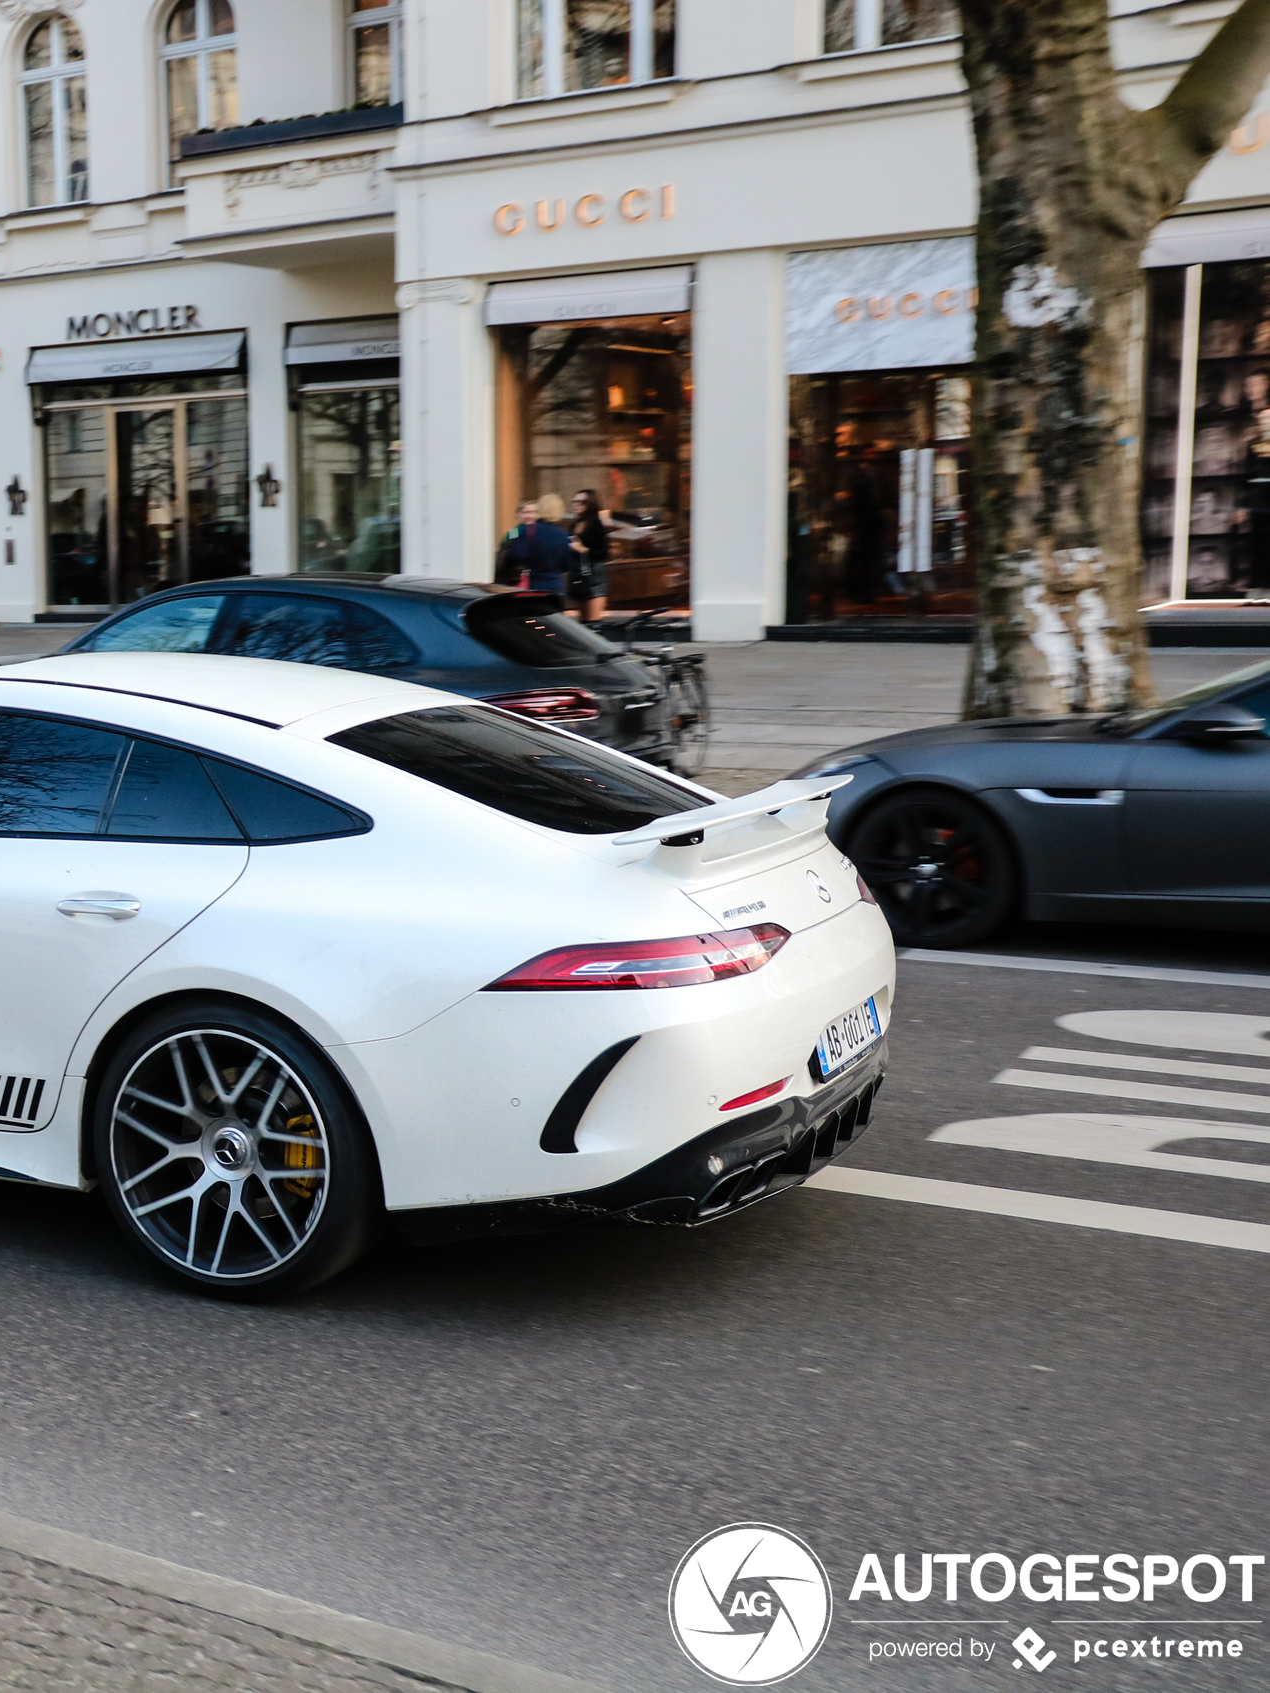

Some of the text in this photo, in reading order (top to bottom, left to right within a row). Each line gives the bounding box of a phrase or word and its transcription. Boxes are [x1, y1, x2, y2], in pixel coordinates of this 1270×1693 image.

[494, 183, 676, 236] GUCCI
[67, 305, 200, 340] MONCLER
[835, 287, 979, 323] GUCCI
